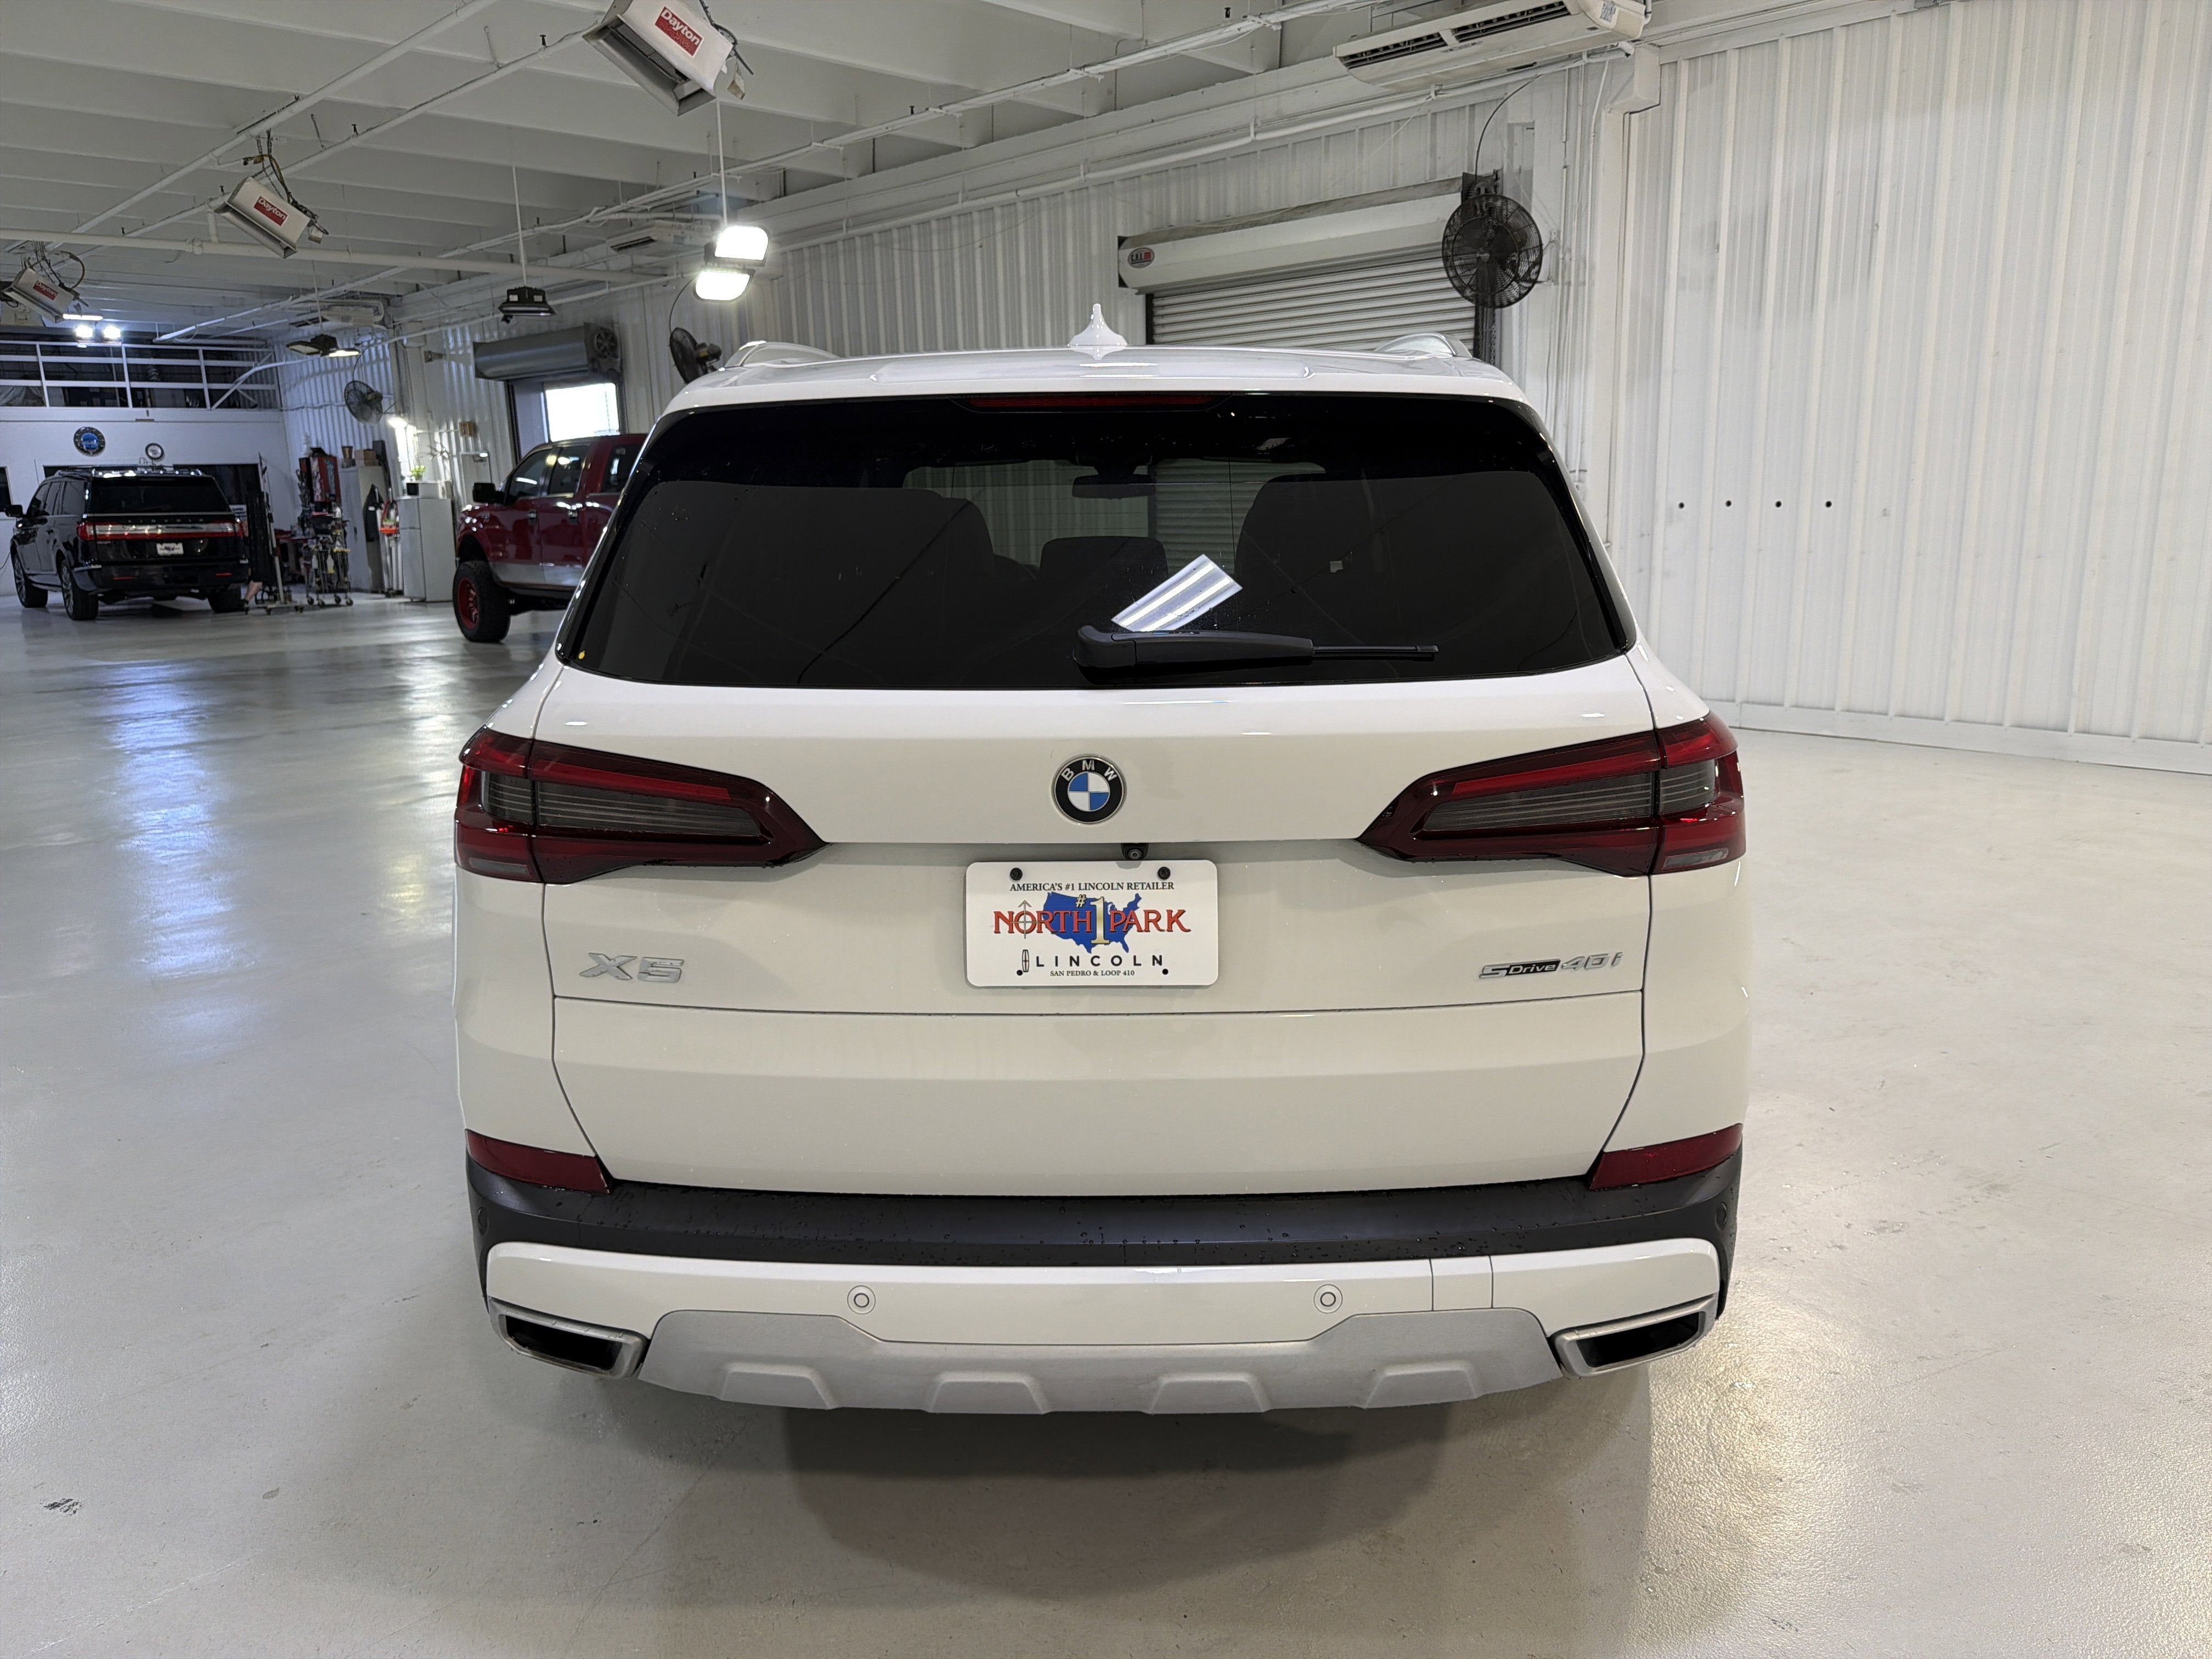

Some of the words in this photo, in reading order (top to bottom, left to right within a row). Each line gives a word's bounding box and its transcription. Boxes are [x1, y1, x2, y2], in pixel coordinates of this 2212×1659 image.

[661, 9, 700, 46] Dayton
[258, 198, 286, 219] Dayton
[1061, 760, 1118, 782] BMW
[1009, 883, 1063, 891] AMERICA'S
[1077, 882, 1124, 891] LINCOLN
[1126, 882, 1175, 890] RETAILER
[994, 910, 1092, 934] NORTH
[1109, 909, 1192, 933] PARK
[579, 952, 684, 983] X5
[1036, 955, 1163, 968] LINCOLN
